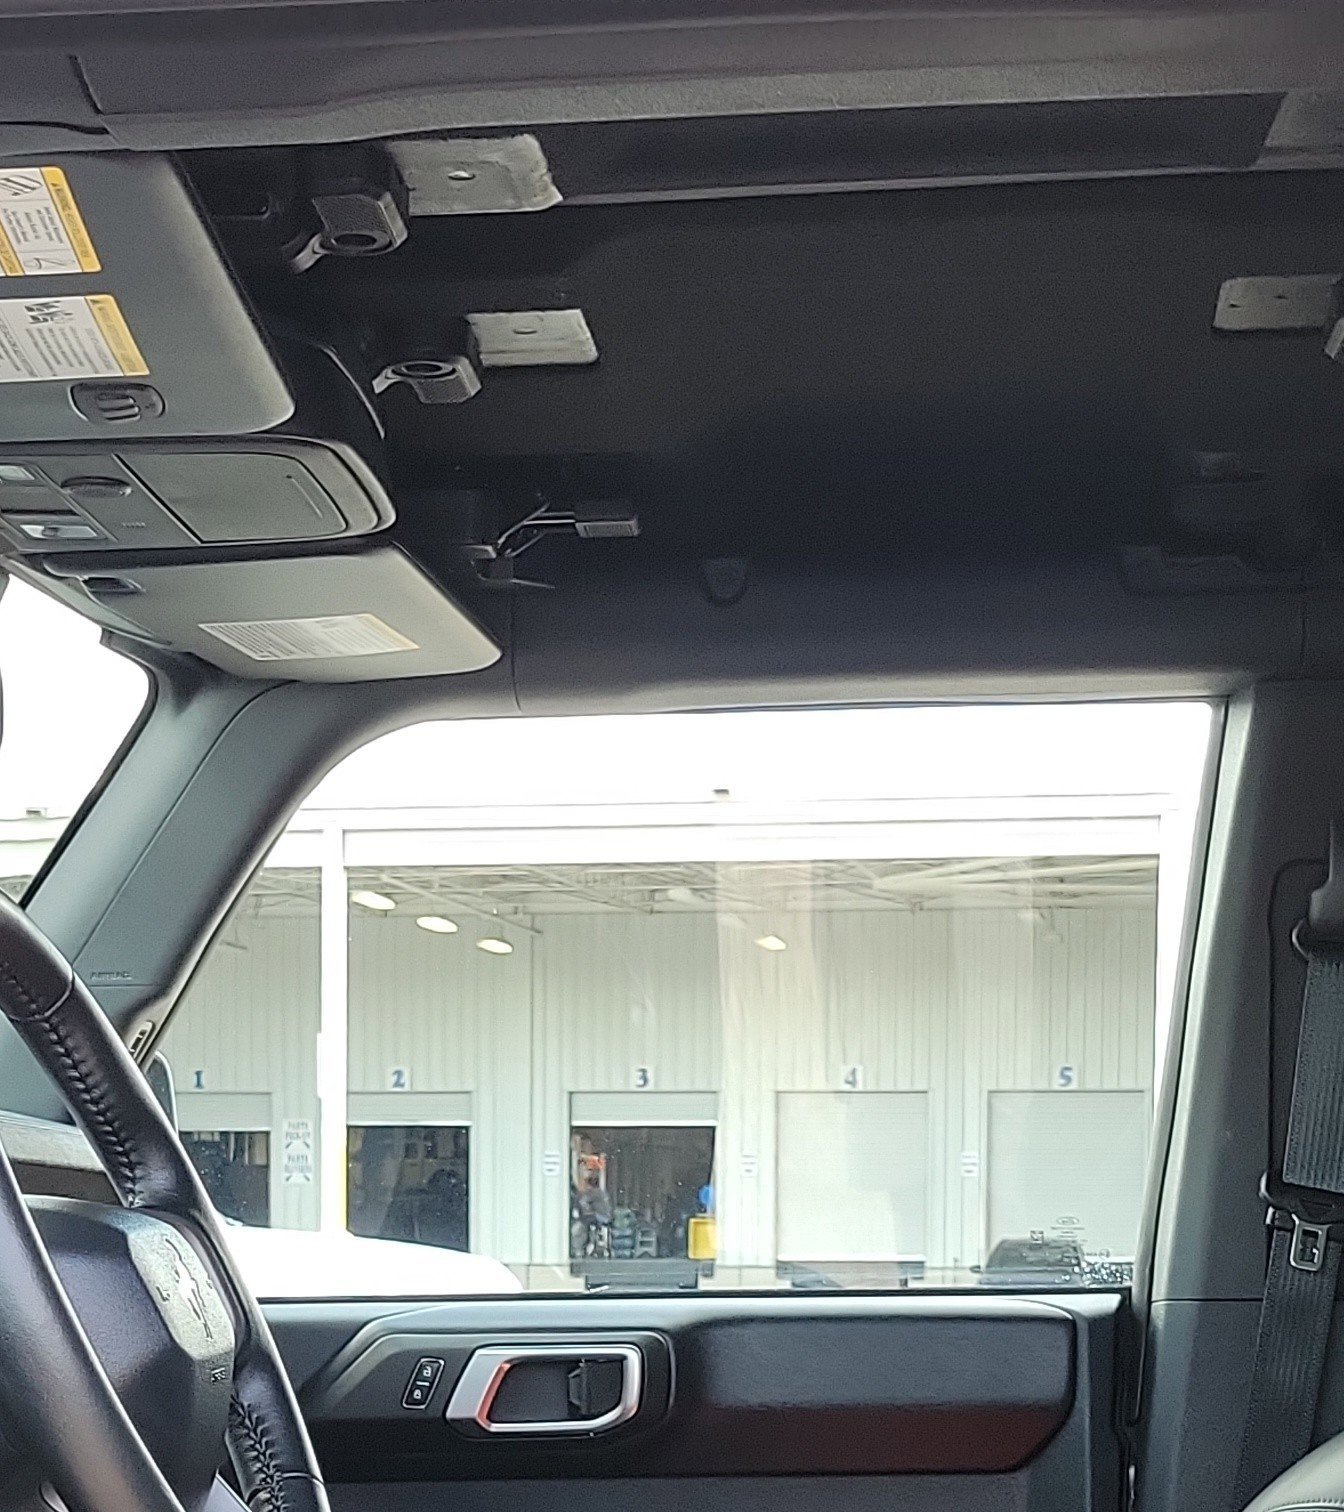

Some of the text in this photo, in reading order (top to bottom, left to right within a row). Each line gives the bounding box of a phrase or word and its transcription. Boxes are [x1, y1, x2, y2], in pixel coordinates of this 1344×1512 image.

[194, 1070, 204, 1088] 1
[392, 1069, 405, 1088] 2
[636, 1068, 649, 1088] 3
[844, 1067, 857, 1088] 4
[1058, 1066, 1073, 1087] 5
